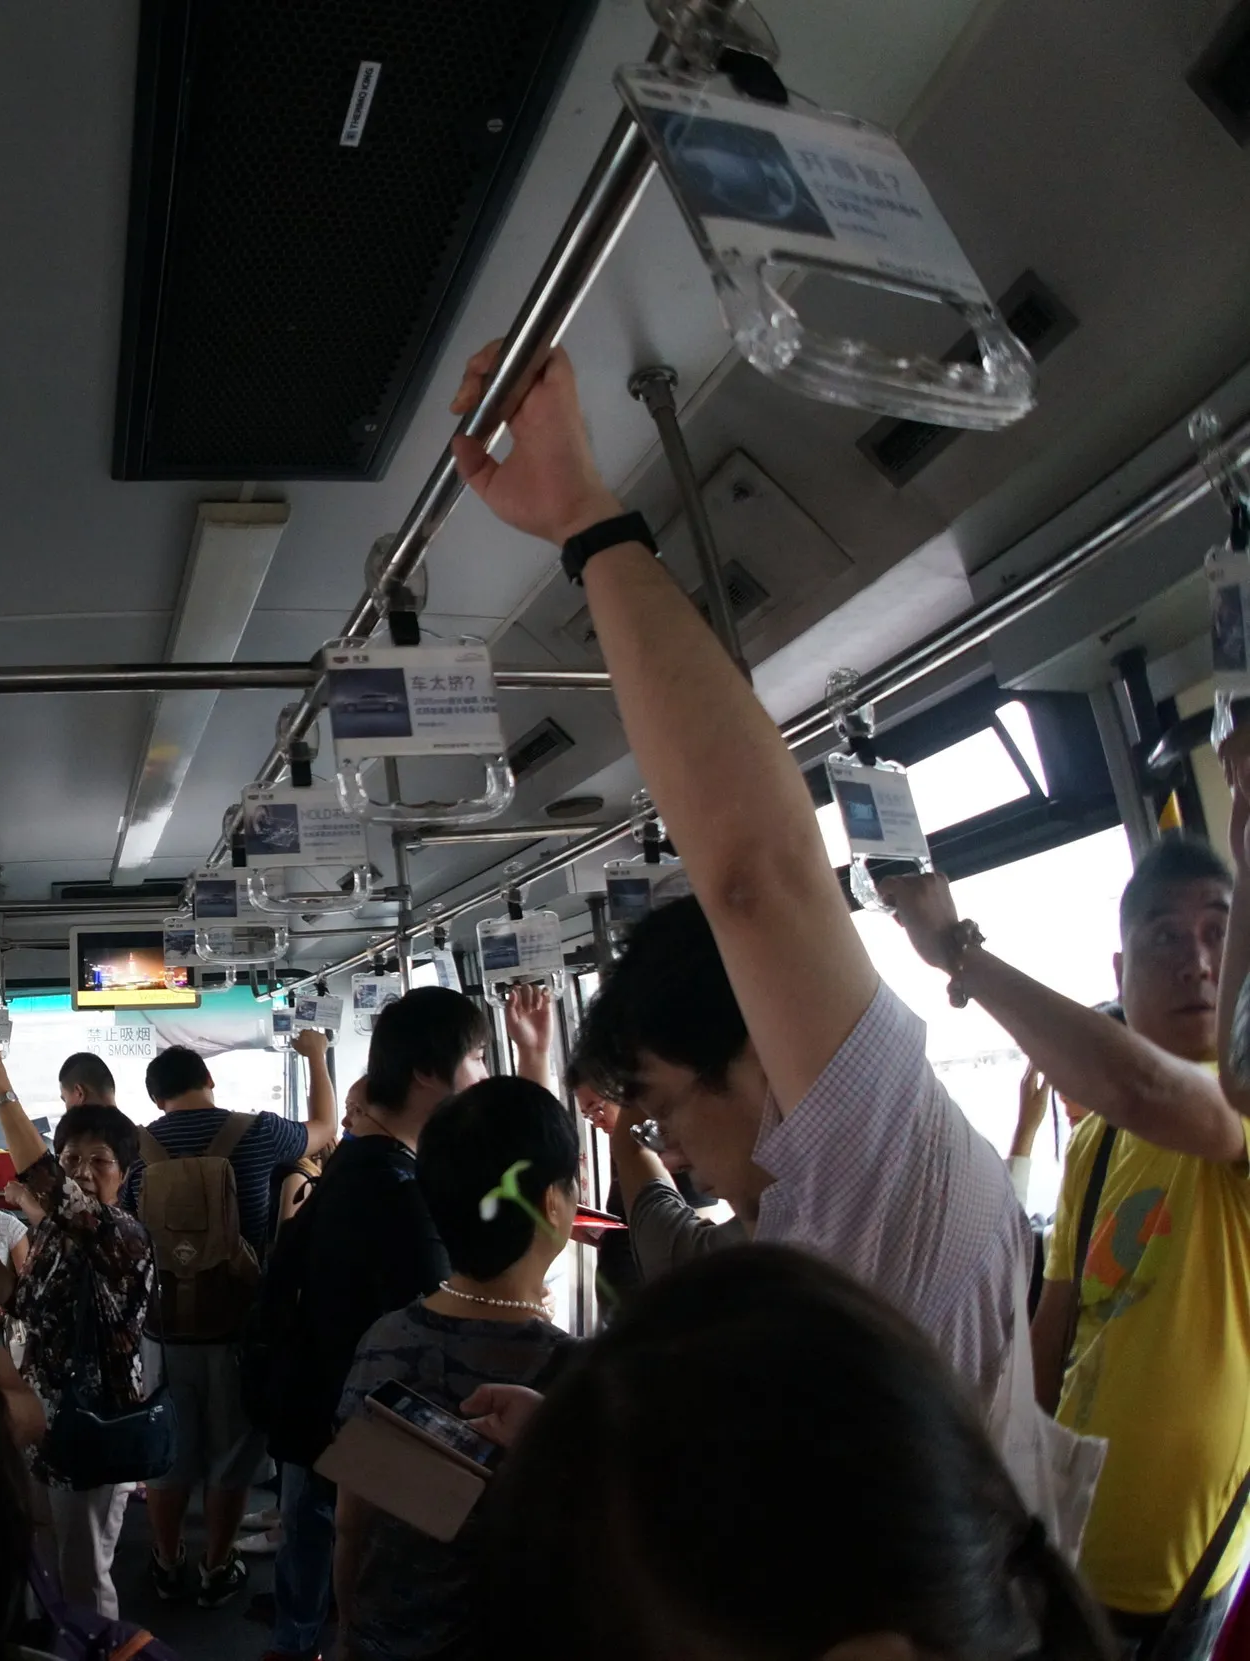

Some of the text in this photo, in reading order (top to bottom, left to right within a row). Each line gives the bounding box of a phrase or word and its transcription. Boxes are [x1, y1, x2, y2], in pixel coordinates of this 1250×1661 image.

[86, 1027, 151, 1042] 禁止吸烟
[108, 1043, 152, 1056] SMOKING
